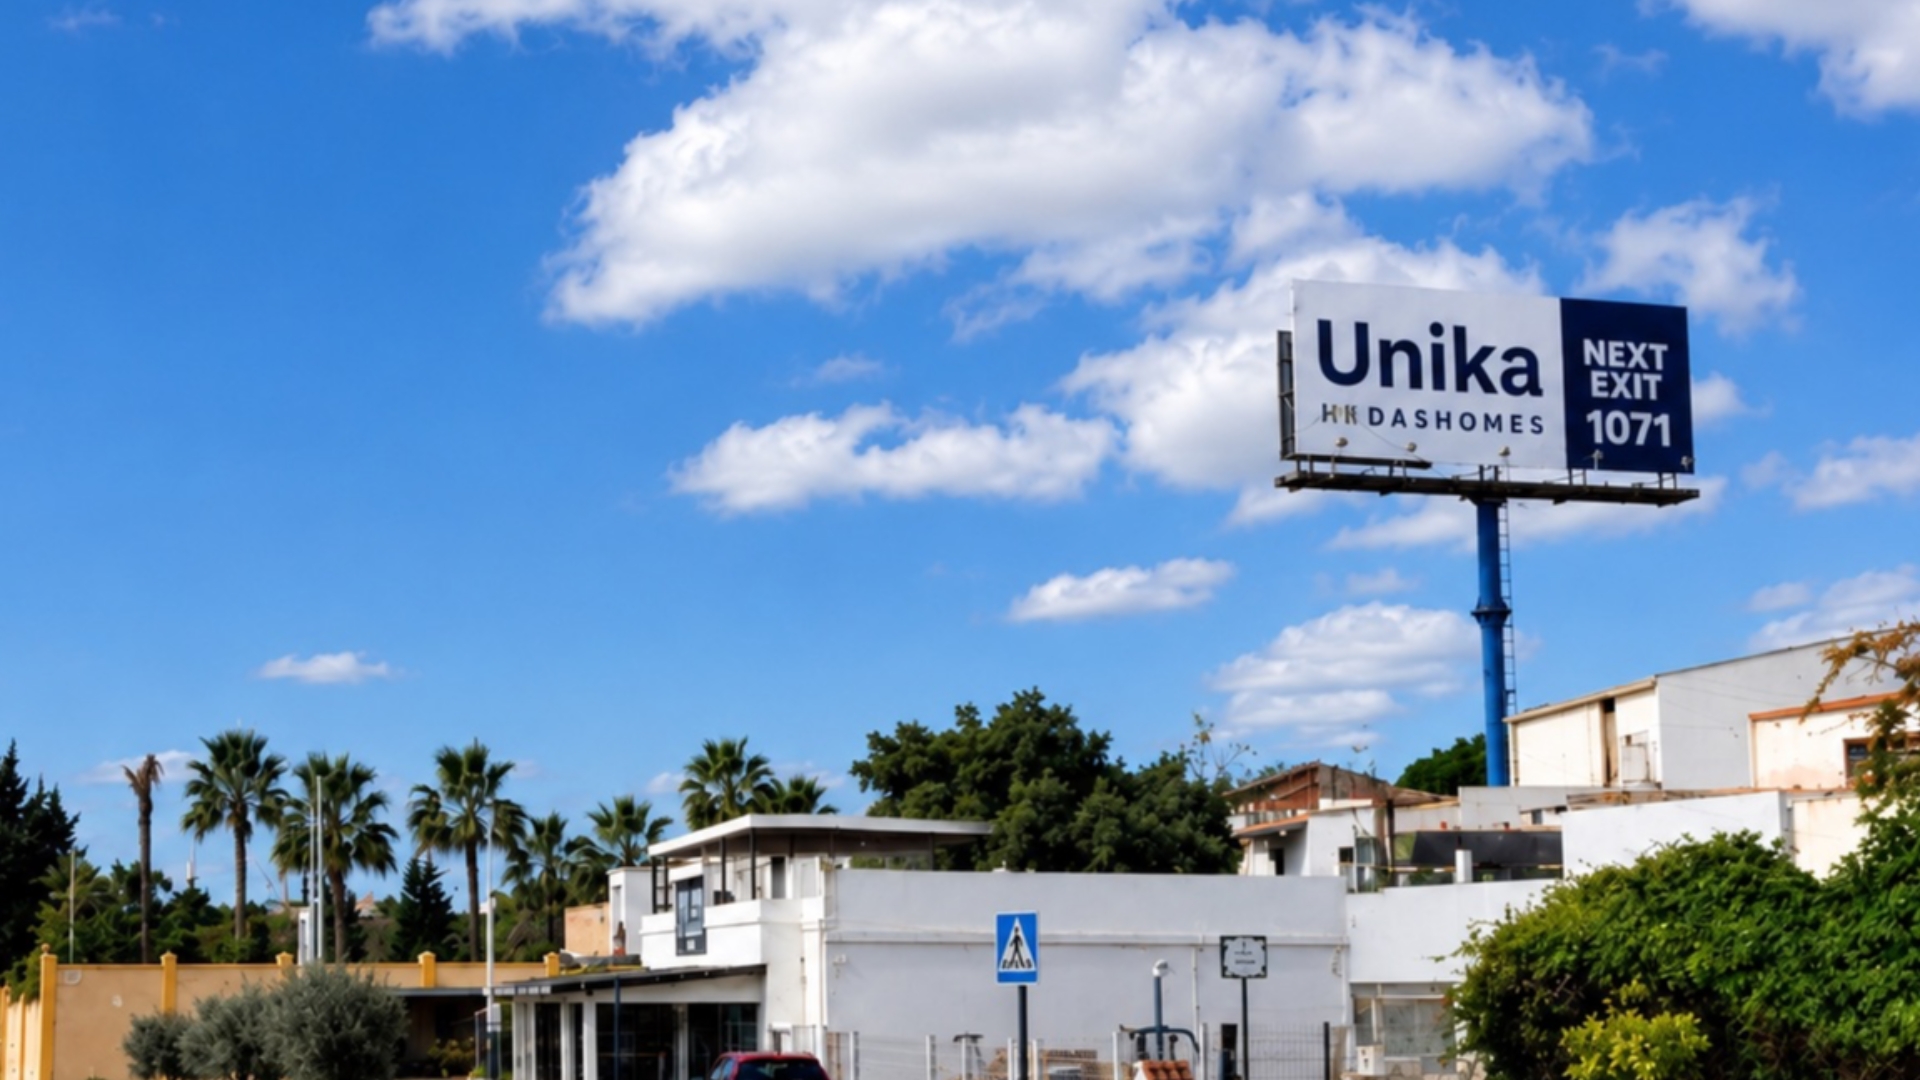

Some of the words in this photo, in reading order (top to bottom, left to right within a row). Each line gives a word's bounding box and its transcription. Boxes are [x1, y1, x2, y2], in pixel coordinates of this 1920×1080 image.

[1317, 318, 1544, 398] Unika
[1583, 338, 1669, 370] NEXT
[1590, 370, 1662, 400] EXIT
[1586, 409, 1671, 447] 1071
